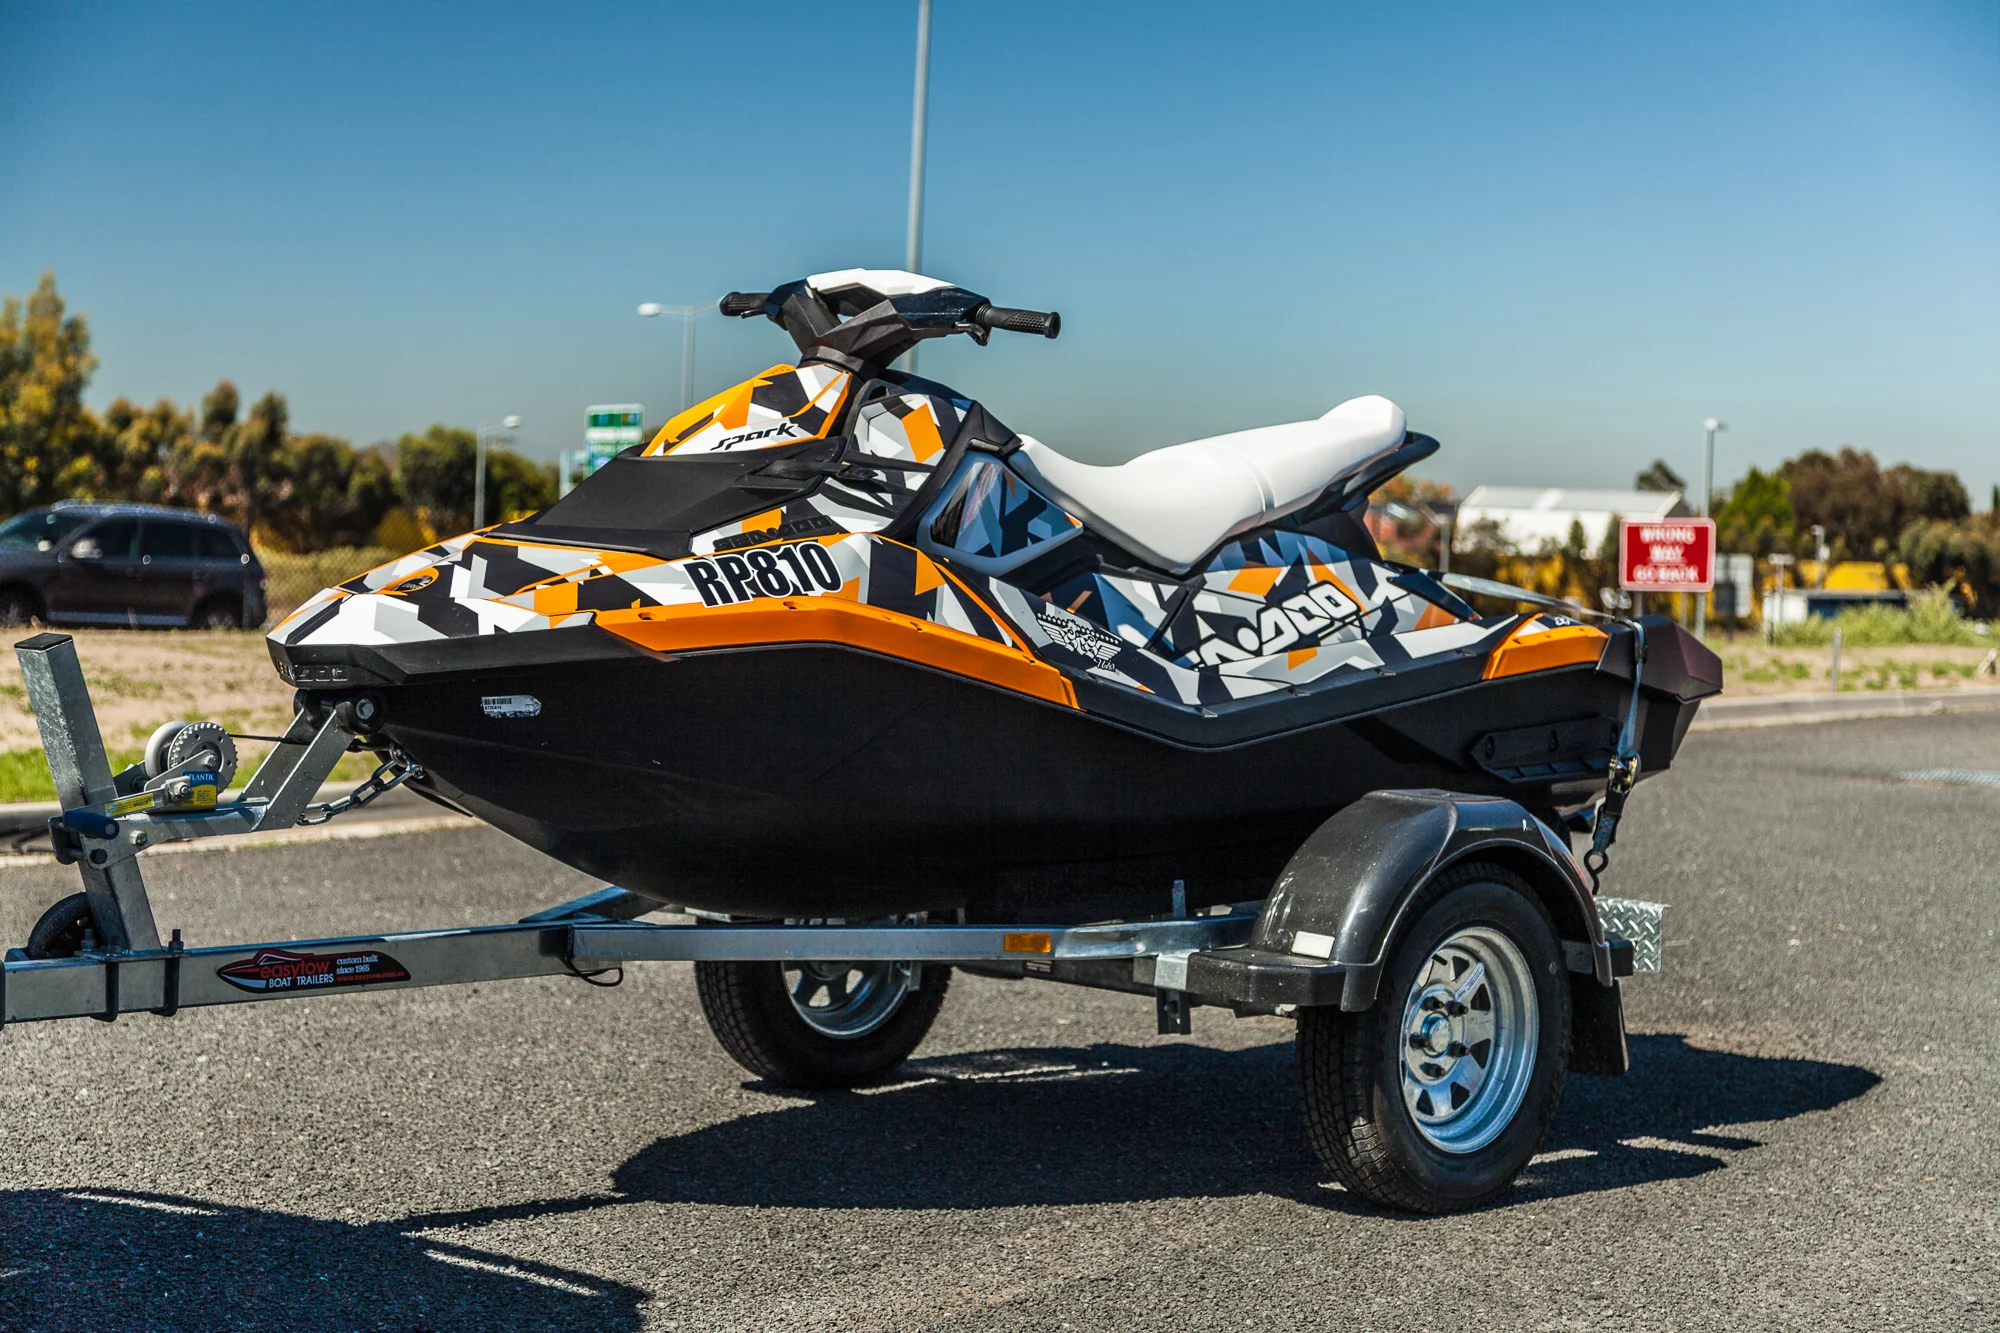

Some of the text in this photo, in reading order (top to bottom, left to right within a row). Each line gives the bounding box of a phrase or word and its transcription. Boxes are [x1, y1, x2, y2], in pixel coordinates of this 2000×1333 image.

[683, 541, 843, 608] RP810
[185, 773, 215, 781] TLANTIC
[336, 954, 379, 966] custom built
[260, 960, 330, 980] easytow
[336, 964, 371, 975] since 1965
[269, 973, 334, 989] BOAT TRAILERS
